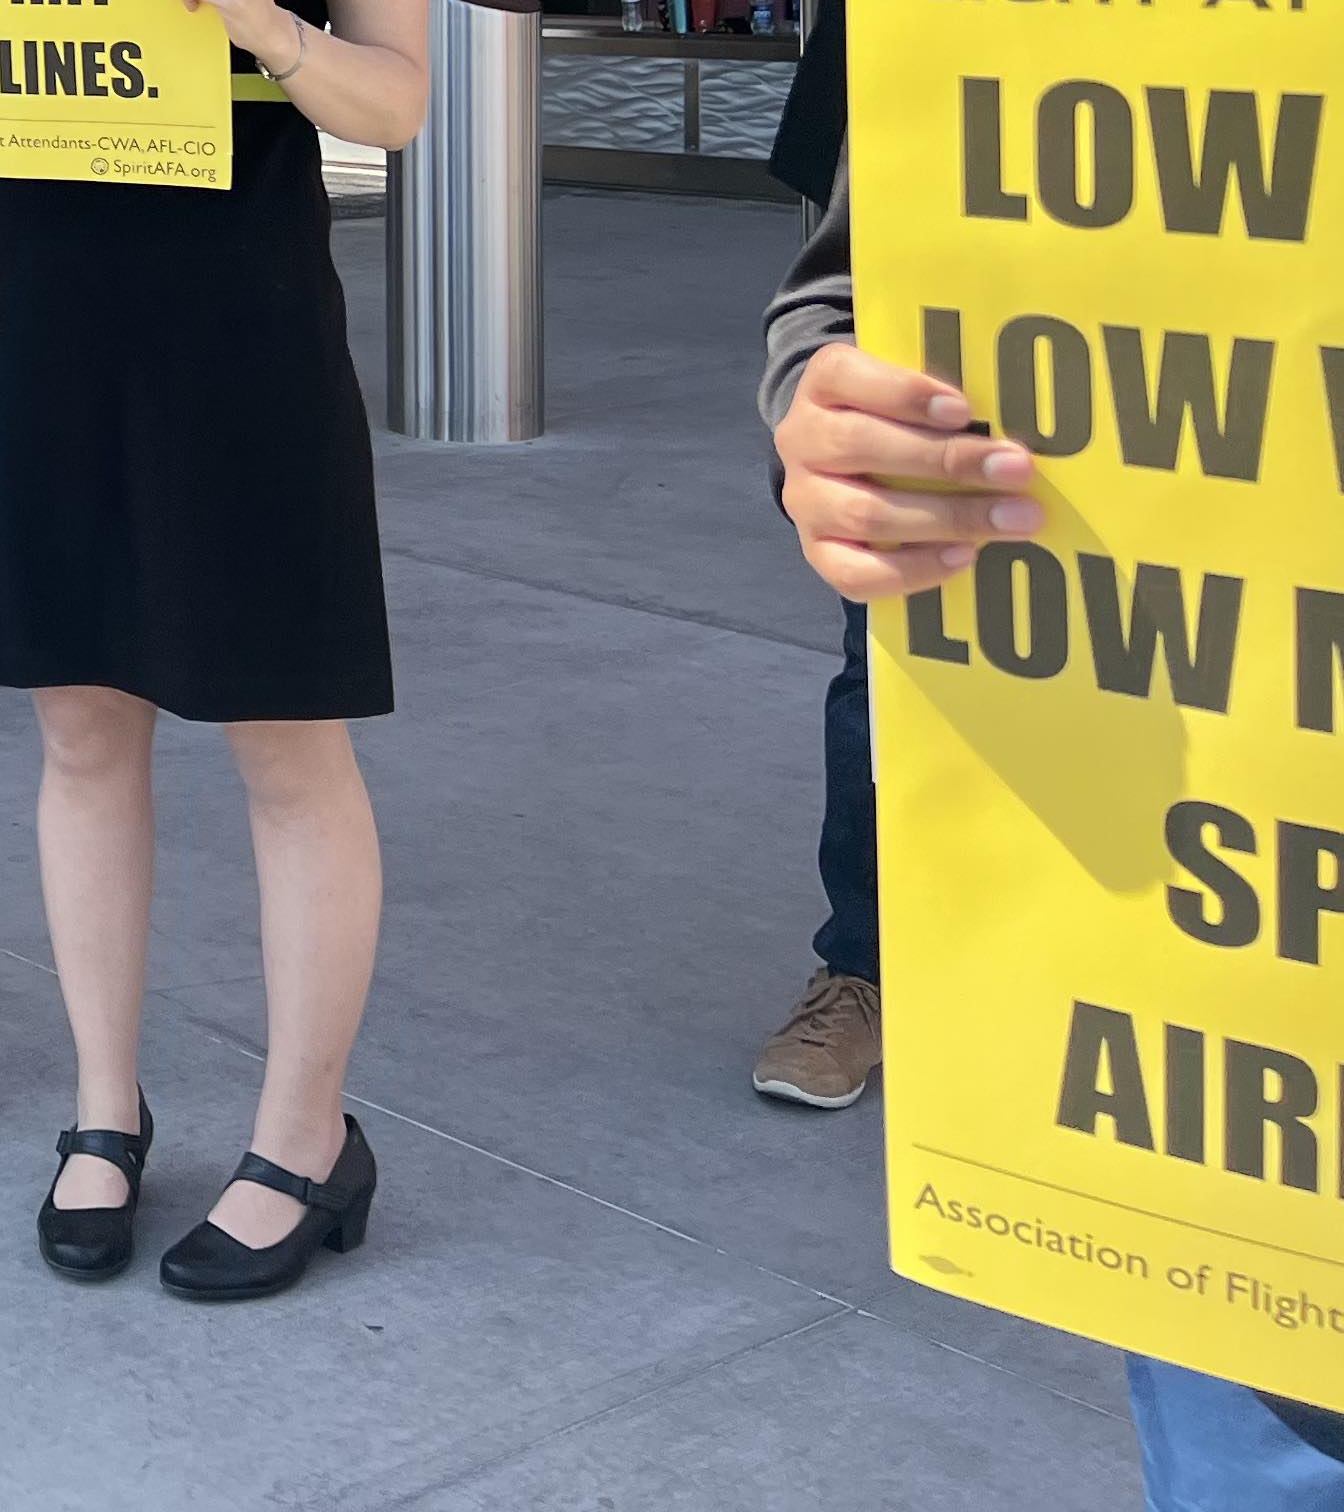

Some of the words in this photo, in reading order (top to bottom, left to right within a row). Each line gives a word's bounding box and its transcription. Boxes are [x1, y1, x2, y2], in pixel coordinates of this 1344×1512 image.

[113, 159, 217, 183] SpiritAFA.org
[147, 140, 216, 156] AFL-CIO
[959, 75, 1325, 243] LOW
[920, 305, 1277, 483] LOW
[905, 540, 1245, 716] LOW
[1055, 1000, 1344, 1199] AIR
[914, 1182, 1148, 1279] Association
[1166, 1264, 1212, 1295] of
[1224, 1270, 1344, 1330] Flight
